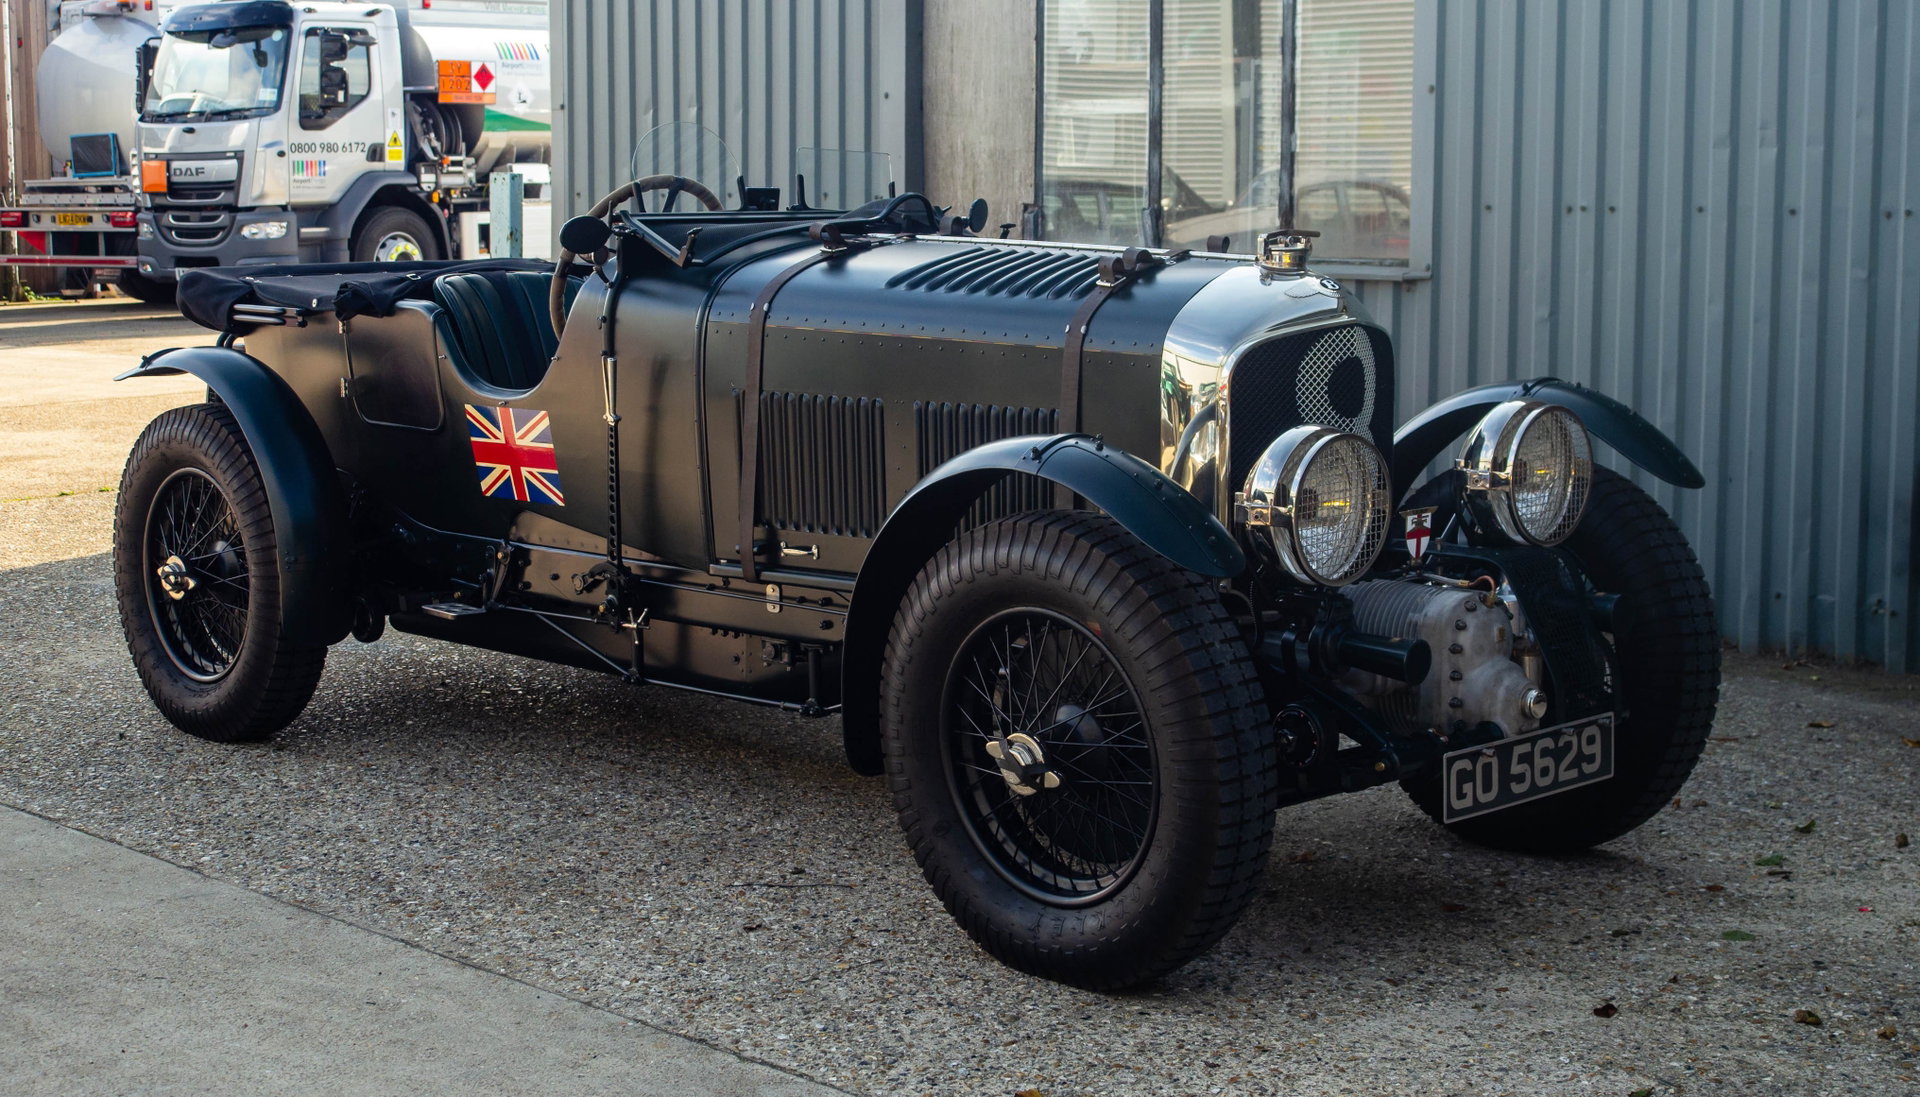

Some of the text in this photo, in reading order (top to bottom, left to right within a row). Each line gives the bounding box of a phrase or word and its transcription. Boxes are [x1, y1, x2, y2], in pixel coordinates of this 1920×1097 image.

[442, 78, 471, 90] 1202
[290, 142, 366, 153] 0800 980 6172
[173, 167, 205, 176] DAF
[1449, 725, 1602, 810] GO 5629
